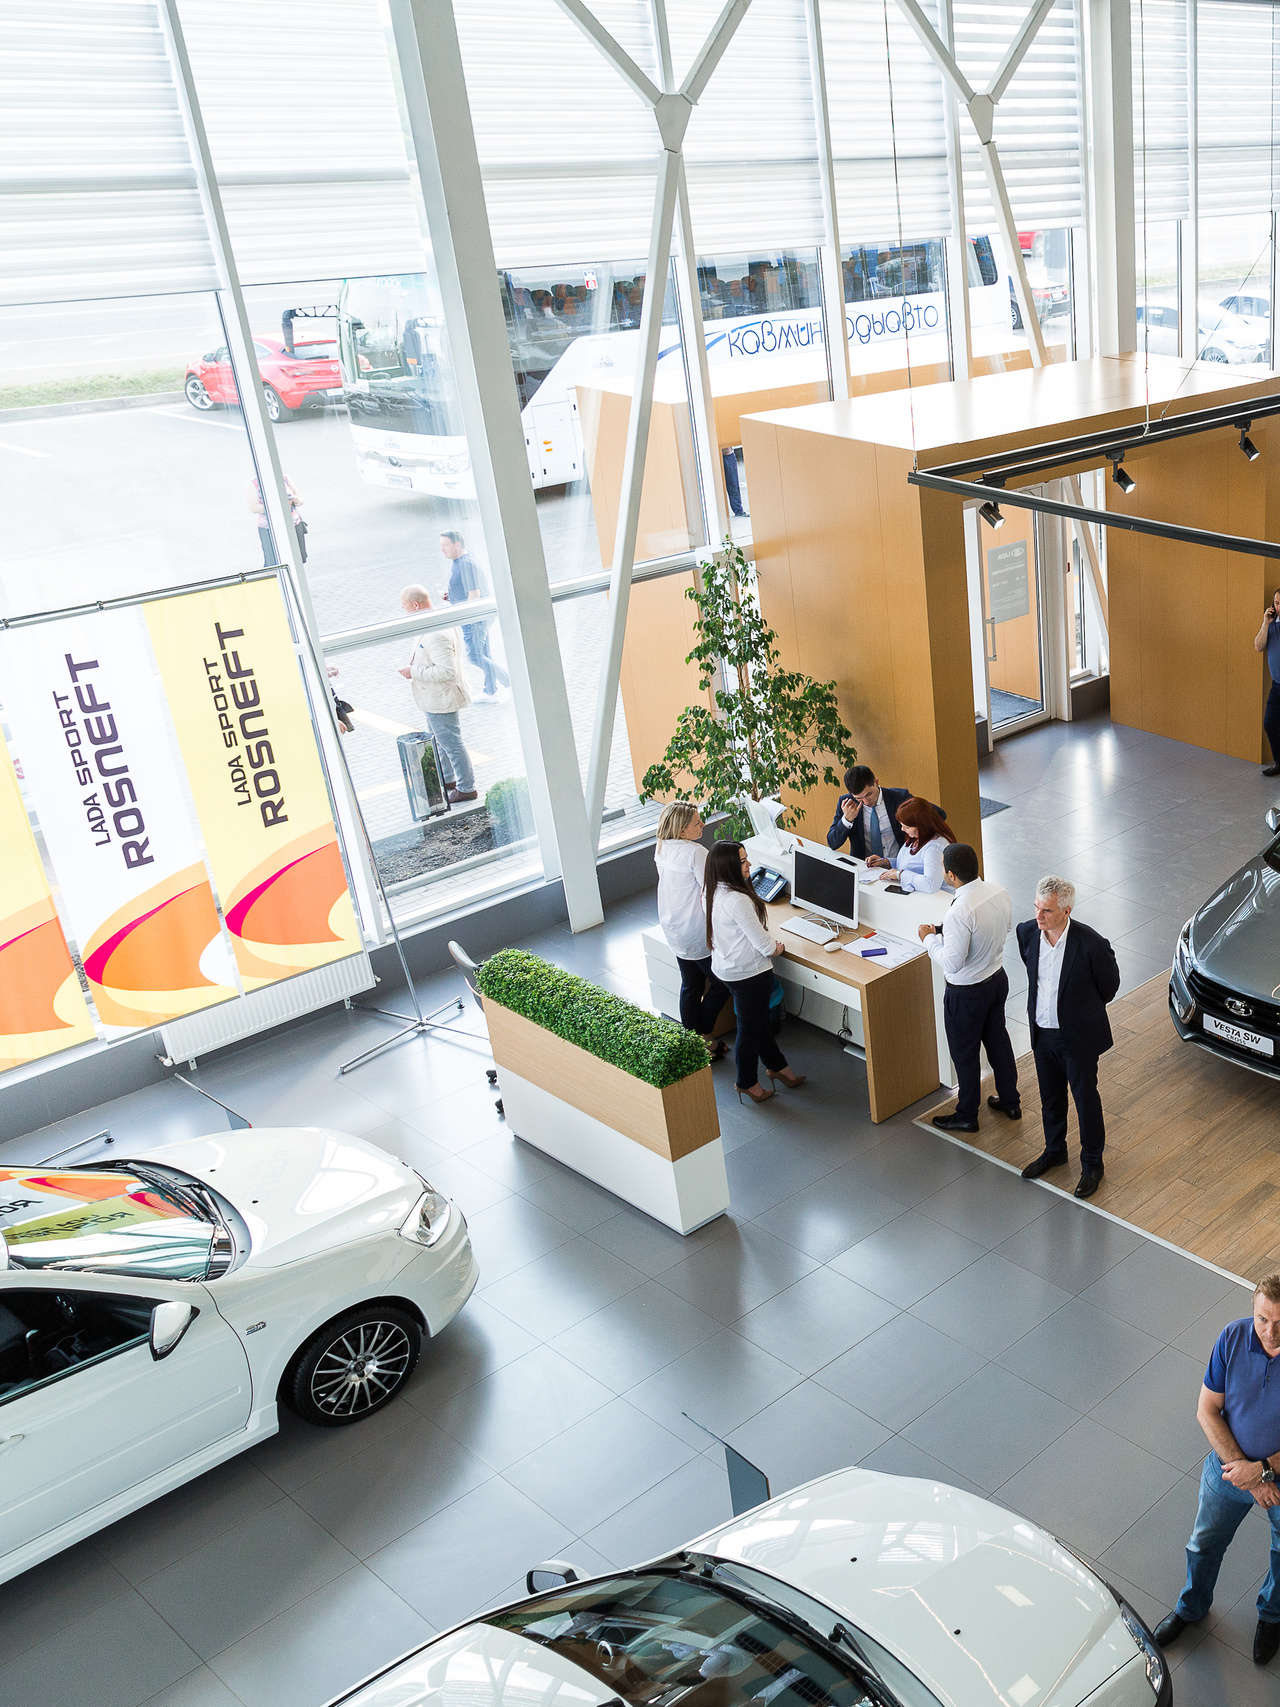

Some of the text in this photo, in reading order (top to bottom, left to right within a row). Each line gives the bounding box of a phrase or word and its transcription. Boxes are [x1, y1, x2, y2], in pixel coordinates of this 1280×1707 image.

[52, 691, 112, 847] LADA SPORT
[65, 653, 155, 869] ROSNEFT
[203, 657, 252, 806] LADA SPORT
[214, 622, 289, 828] ROSNEFT
[1213, 1019, 1242, 1039] VESTA
[1243, 1031, 1261, 1045] SW
[1225, 1033, 1247, 1045] CROSS
